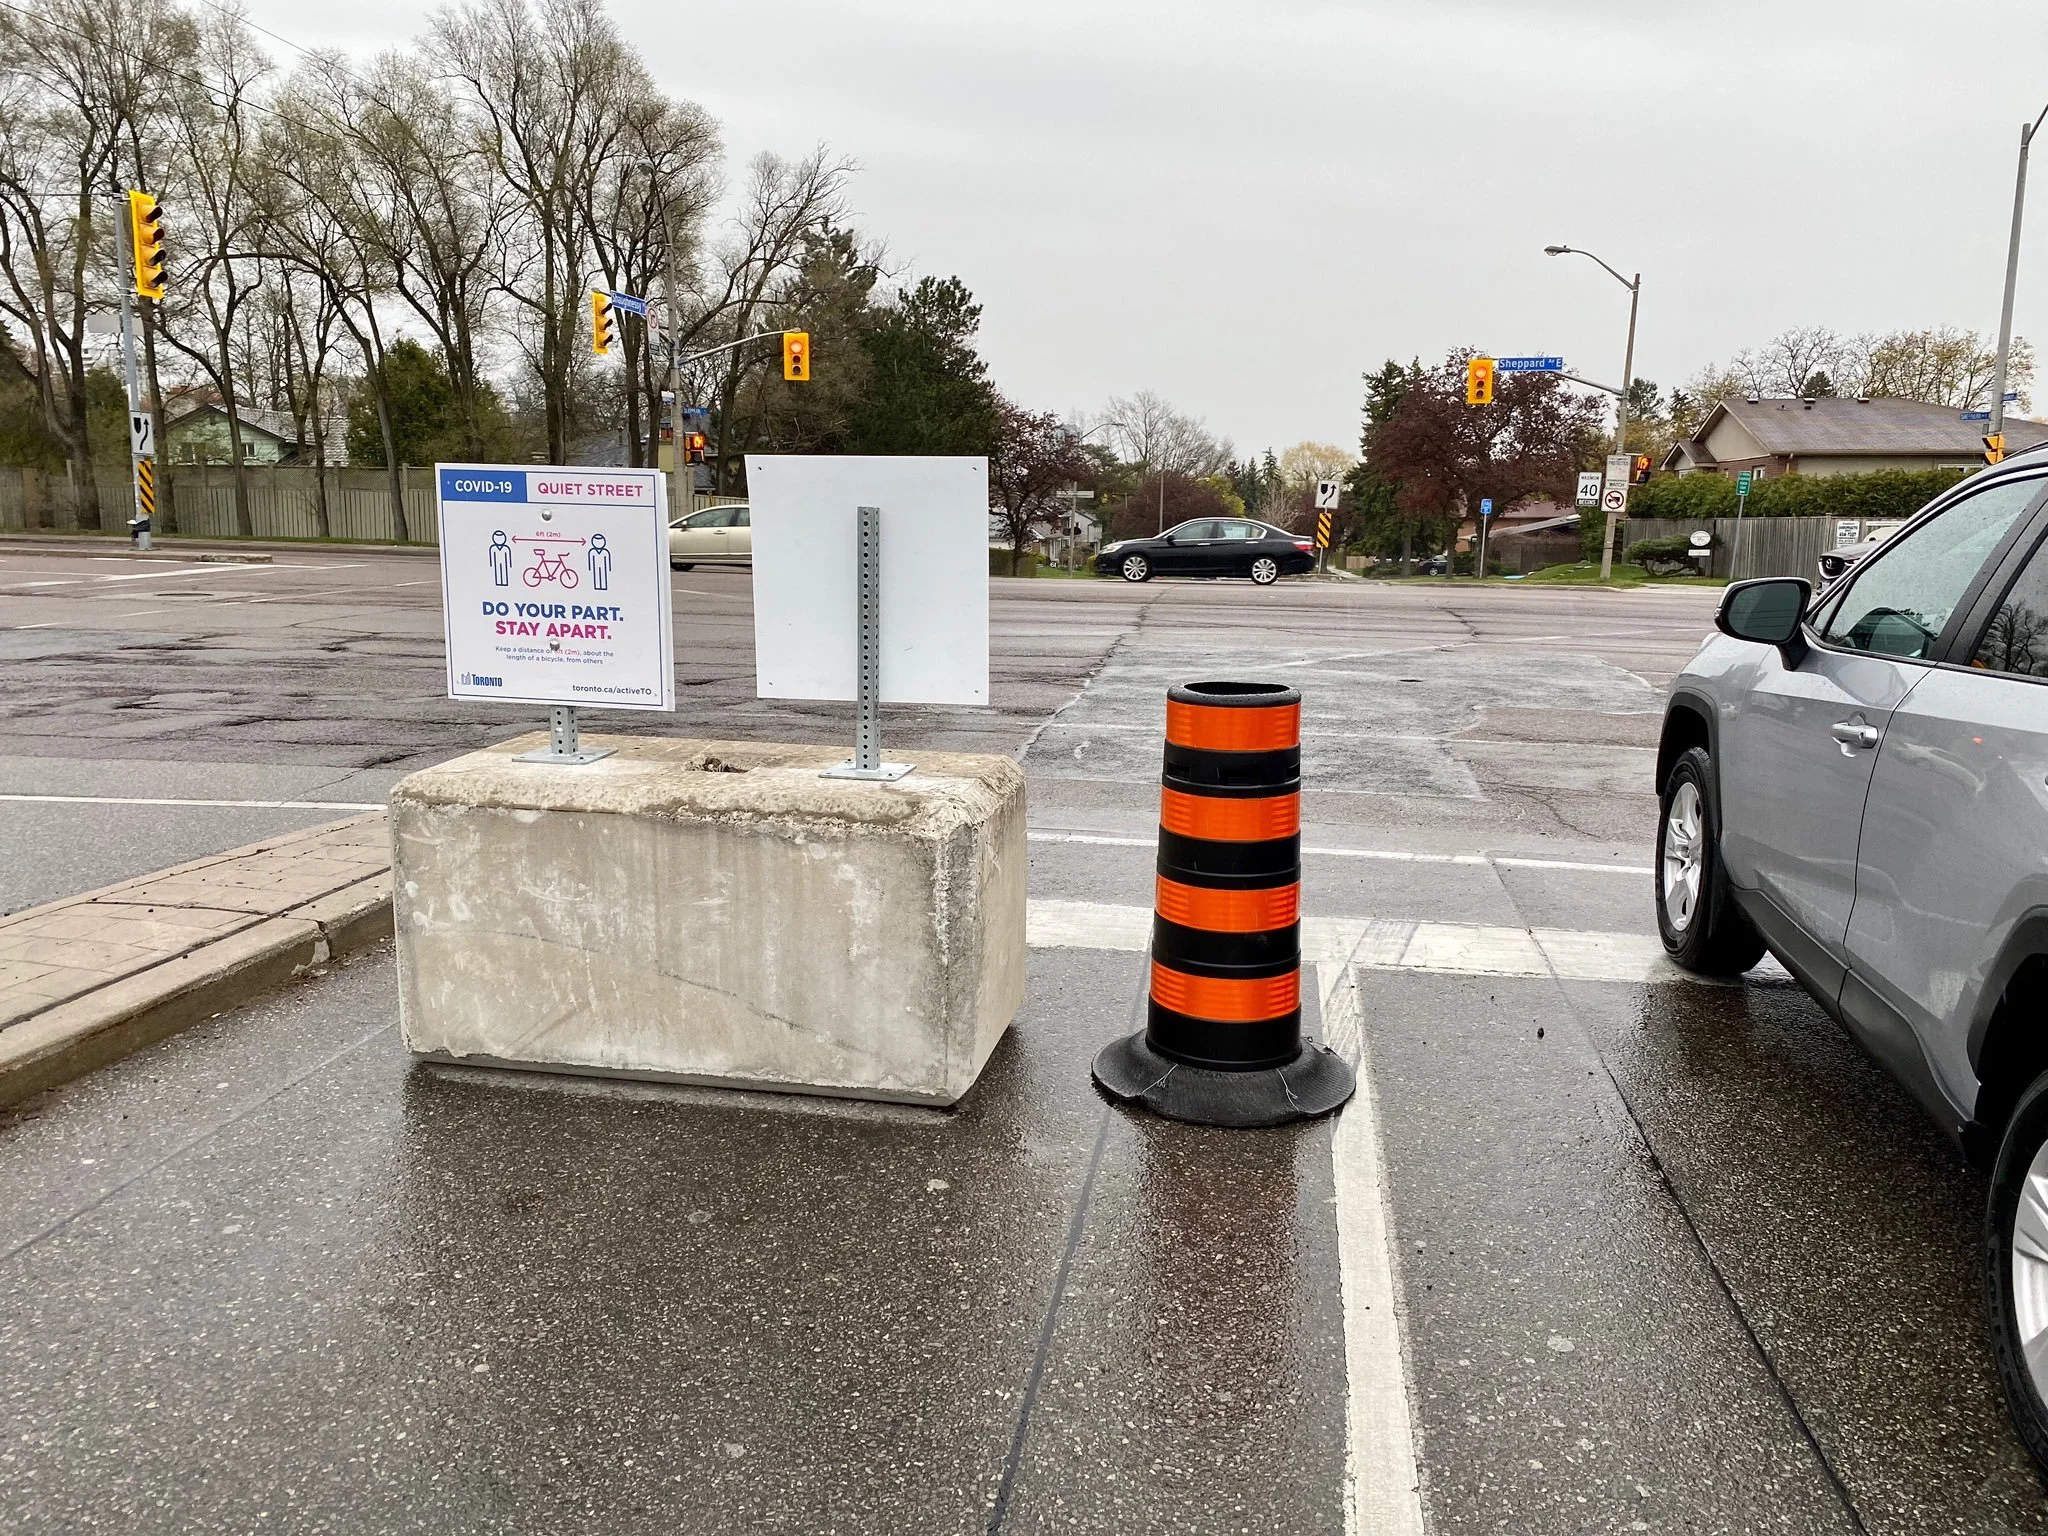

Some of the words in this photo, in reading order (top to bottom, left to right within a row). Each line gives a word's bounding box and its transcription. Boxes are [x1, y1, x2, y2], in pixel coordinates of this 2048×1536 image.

[1499, 358, 1545, 370] Sheppard
[1556, 358, 1562, 368] E
[455, 480, 512, 493] COVID-19
[538, 482, 582, 495] QUIET
[587, 484, 643, 497] STREET
[1580, 484, 1598, 497] 40
[482, 601, 509, 616] DO
[514, 603, 566, 619] YOUR
[571, 605, 624, 621] PART.
[495, 620, 540, 636] STAY
[545, 623, 612, 640] APART.
[506, 653, 527, 662] length
[471, 673, 503, 687] TORONTO
[572, 683, 652, 696] toronto.ca/activeTO
